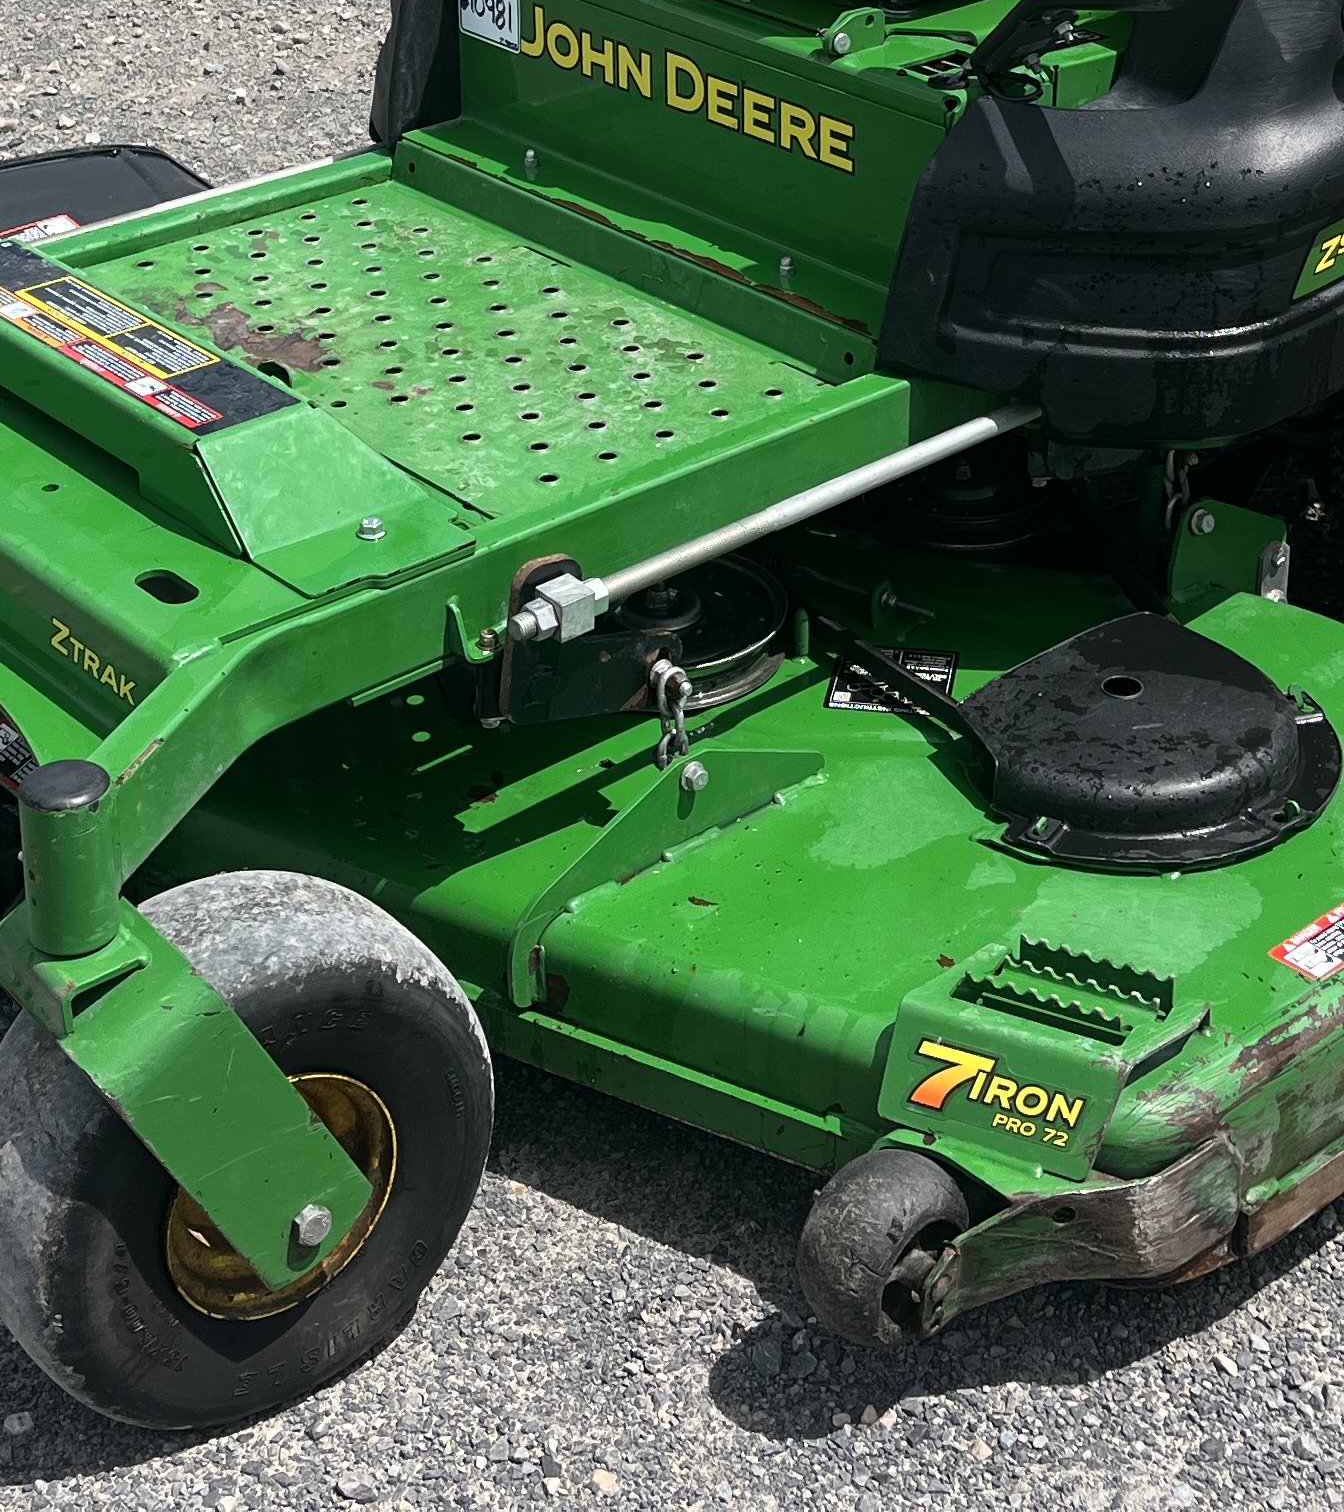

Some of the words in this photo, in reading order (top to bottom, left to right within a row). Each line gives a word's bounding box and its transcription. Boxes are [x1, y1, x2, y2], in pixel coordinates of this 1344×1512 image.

[521, 5, 652, 99] JOHN
[665, 51, 854, 173] DEERE
[50, 618, 137, 706] ZTRAK
[992, 1113, 1037, 1137] PRO
[1042, 1127, 1069, 1148] 72
